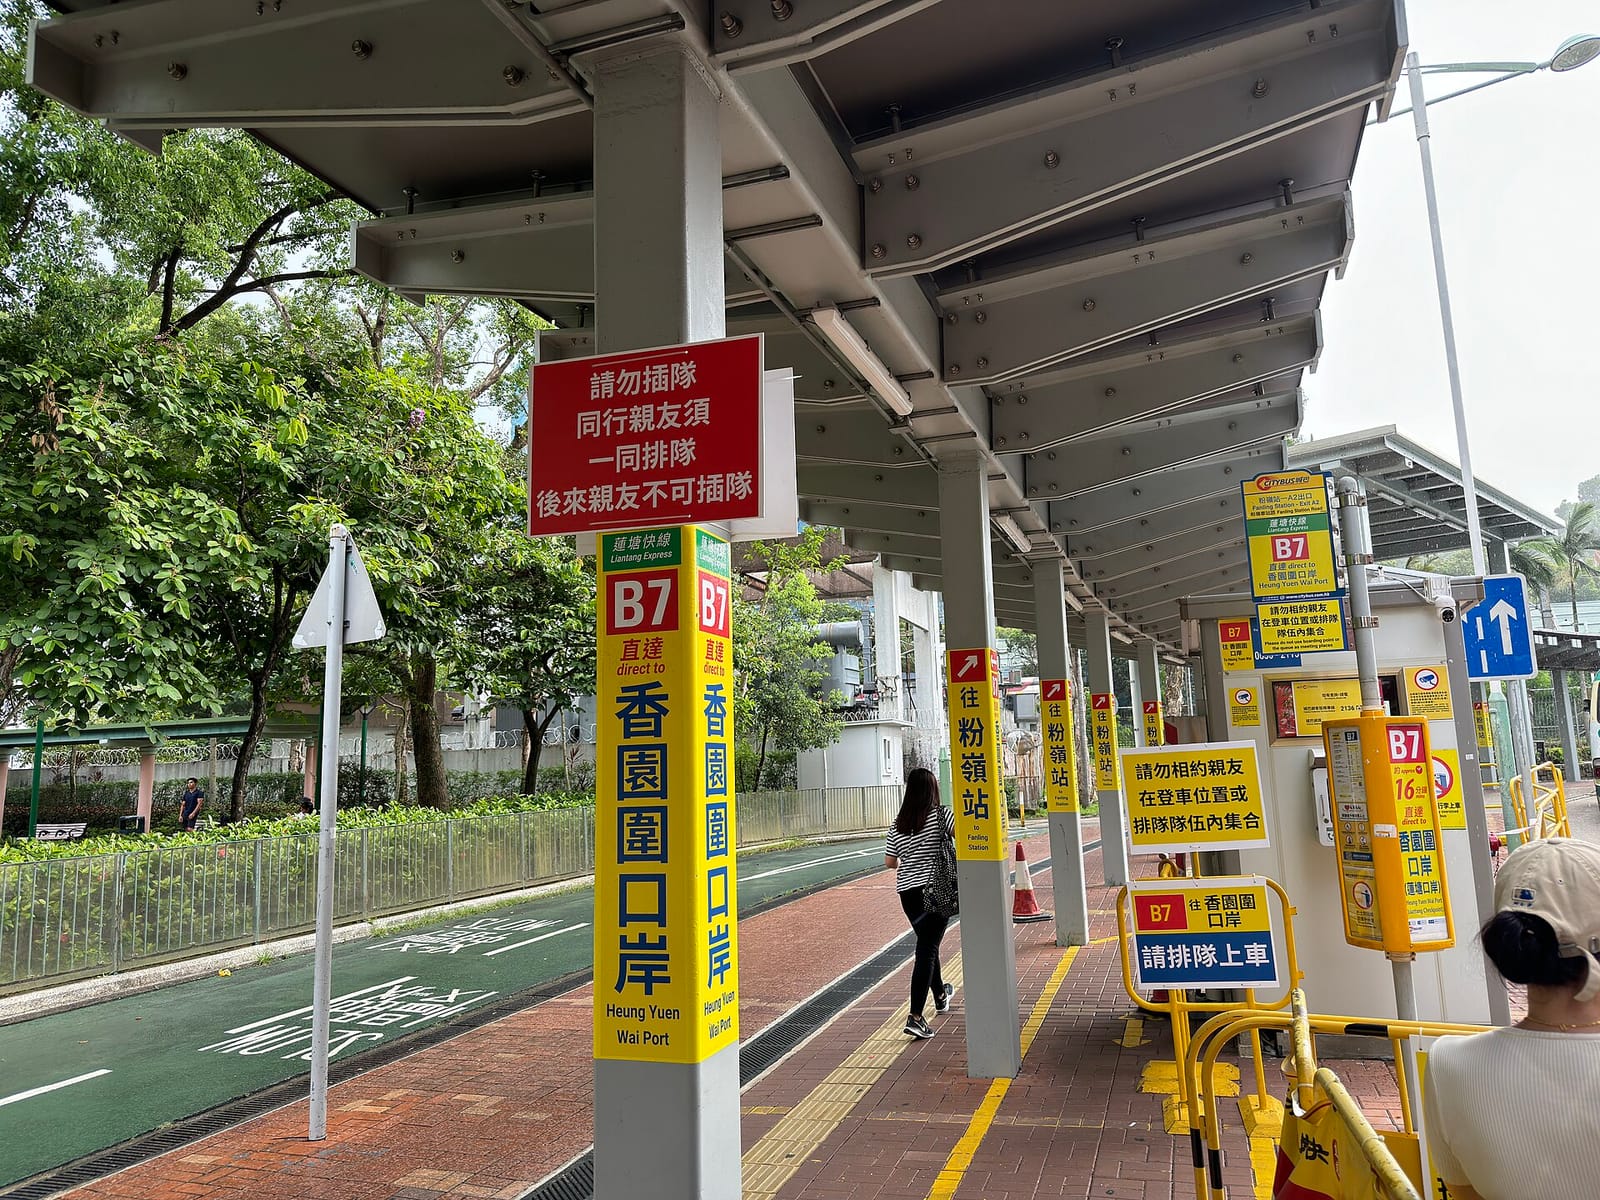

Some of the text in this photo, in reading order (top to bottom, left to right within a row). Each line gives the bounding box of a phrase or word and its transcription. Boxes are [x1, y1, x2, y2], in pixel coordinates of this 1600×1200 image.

[589, 360, 697, 400] 請勿插隊
[576, 397, 711, 439] 同行親友須
[588, 437, 697, 473] 一同排隊
[536, 470, 753, 518] 後來親友不可插隊
[612, 532, 671, 552] 蓮塘快線
[1275, 538, 1305, 559] B7
[610, 550, 673, 564] Liantang Express
[614, 578, 671, 629] B7
[701, 578, 727, 631] B7
[1269, 603, 1327, 615] 請勿相約親友
[1261, 613, 1338, 627] 在登車位置或排隊
[1228, 627, 1240, 637] B7
[620, 636, 664, 662] 直達
[704, 638, 724, 663] 直達
[617, 662, 666, 676] direct to
[703, 660, 725, 676] direct to
[958, 686, 989, 820] 往粉嶺站
[1048, 704, 1069, 788] 往粉嶺站
[1389, 729, 1419, 760] B7
[1134, 758, 1244, 781] 請勿相約親友
[1138, 785, 1249, 808] 在登車位置或
[1395, 778, 1414, 800] 16
[1133, 811, 1260, 835] 排隊隊伍內集合
[1404, 806, 1423, 818] 直達
[614, 681, 671, 996] 香園圍口岸
[703, 683, 731, 990] 香園圍口岸
[967, 834, 989, 842] Fanling
[1399, 829, 1436, 852] 香園圍
[1408, 854, 1432, 877] 口岸
[1150, 904, 1171, 922] B7
[1189, 894, 1256, 911] 往 香園圍
[1208, 912, 1242, 928] 口岸
[1141, 942, 1270, 969] 請排隊上車
[606, 1003, 680, 1022] Heung Yuen
[704, 991, 735, 1016] Heung Yuen
[617, 1030, 669, 1046] Wai Port
[708, 1016, 731, 1040] Wai Port
